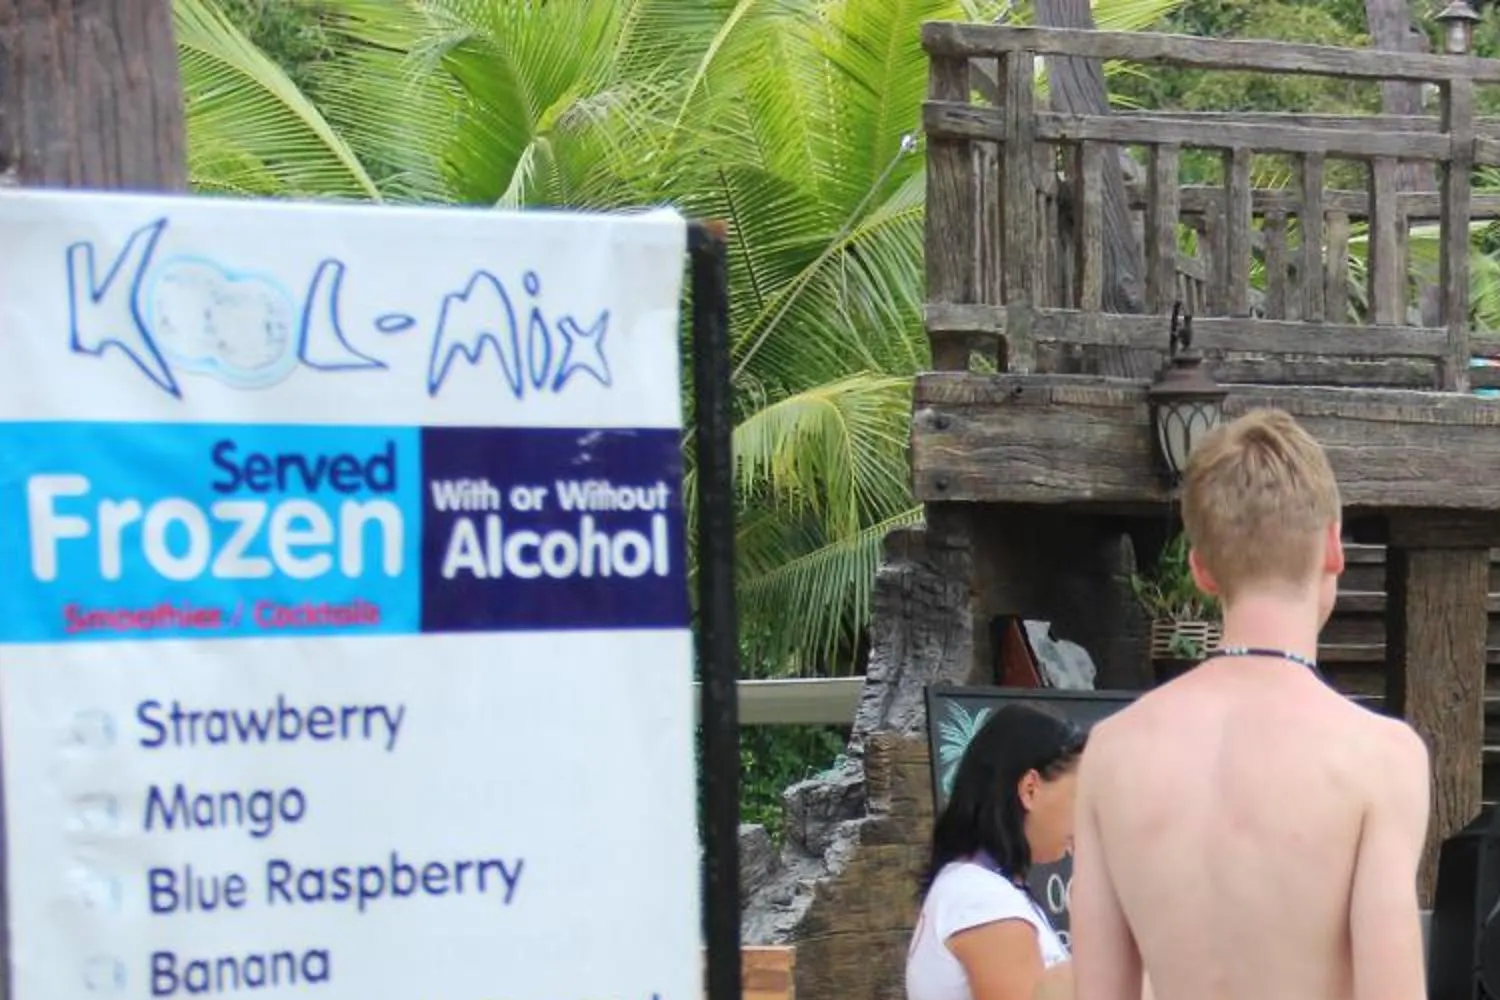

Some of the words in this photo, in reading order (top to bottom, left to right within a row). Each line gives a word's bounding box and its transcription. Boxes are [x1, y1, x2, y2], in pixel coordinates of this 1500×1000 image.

[212, 440, 396, 494] Served
[431, 479, 500, 512] With
[510, 485, 549, 512] or
[556, 479, 670, 512] Without
[26, 473, 404, 581] Frozen
[442, 514, 669, 579] Alcohol
[137, 694, 406, 751] Strawberry
[144, 784, 306, 838] Mango
[148, 865, 247, 915] Blue
[267, 852, 524, 913] Raspberry
[150, 948, 331, 997] Banana
